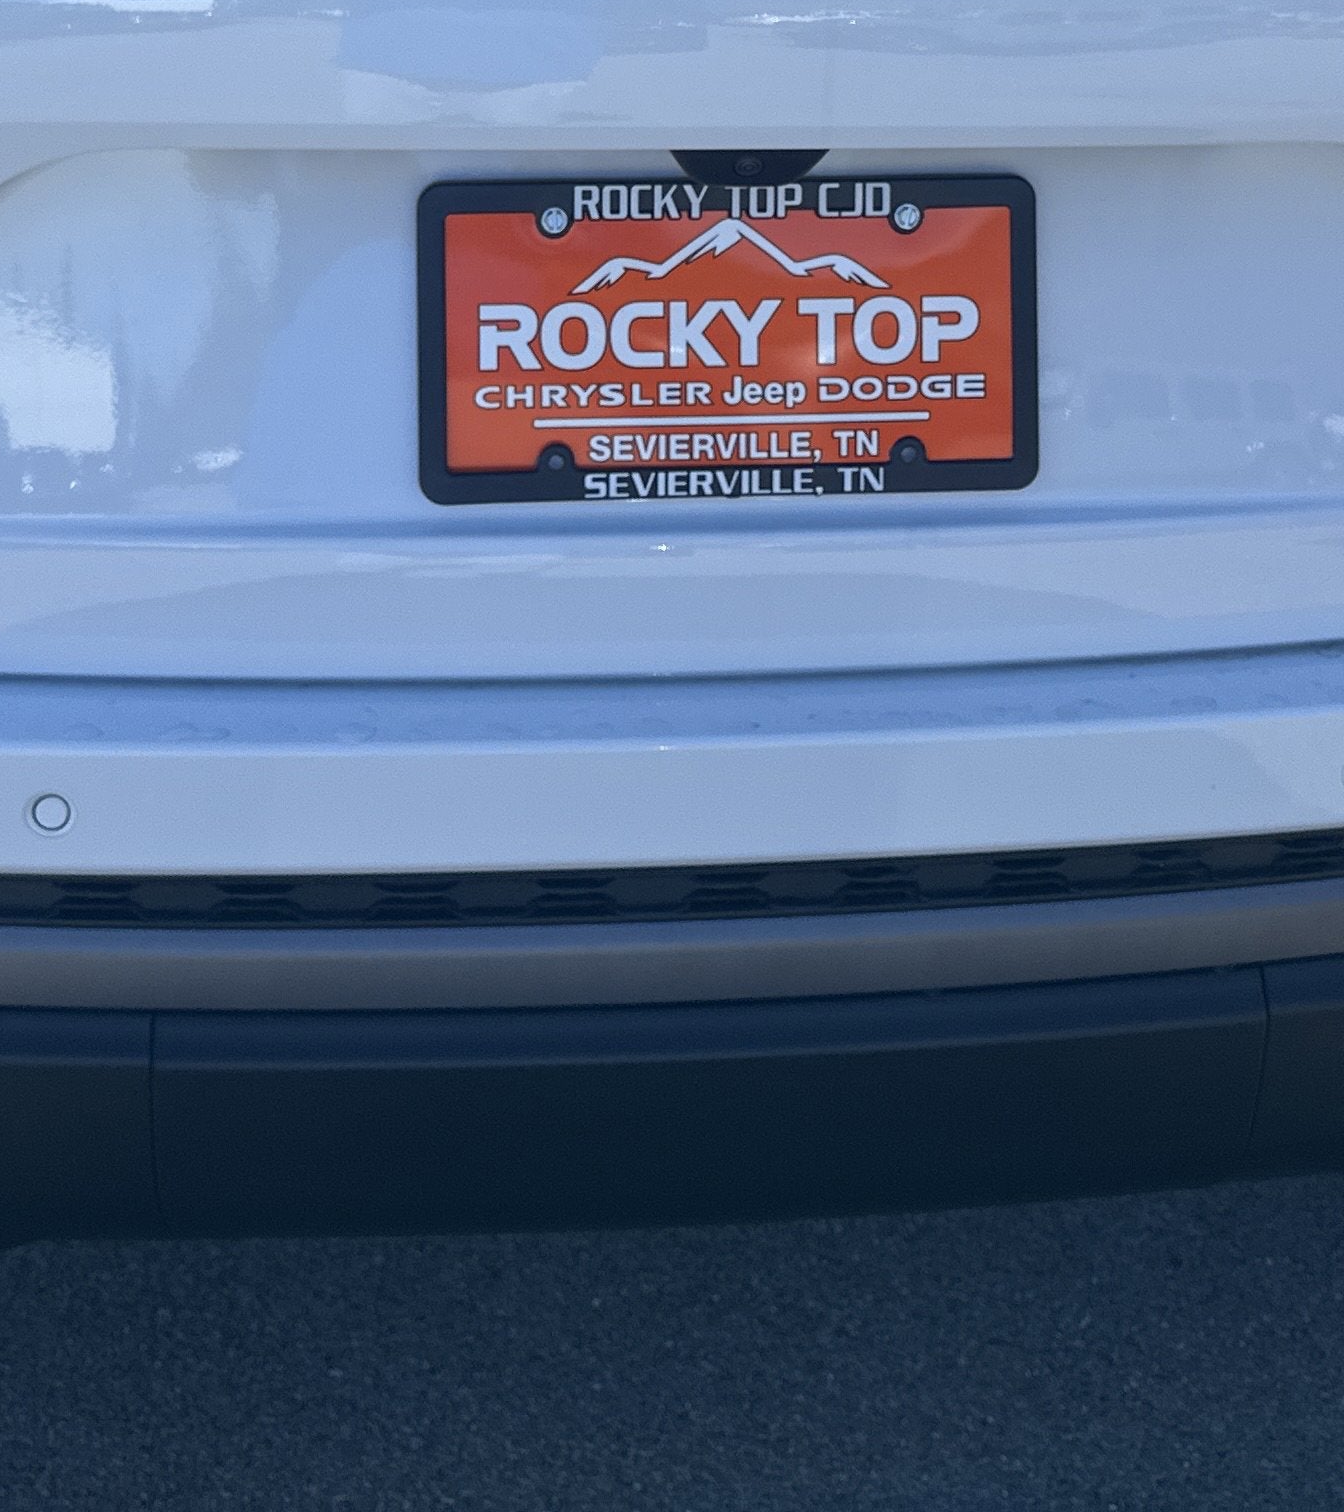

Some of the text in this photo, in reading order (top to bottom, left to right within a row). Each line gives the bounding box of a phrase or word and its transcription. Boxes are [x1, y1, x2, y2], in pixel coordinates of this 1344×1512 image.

[573, 180, 892, 221] ROCKY TOP CJD
[478, 295, 981, 371] ROCKY TOP
[474, 373, 986, 409] CHRYSLER Jeep DODGE
[589, 430, 879, 463] SEVIERVILLE, TN
[584, 467, 885, 499] SEVIERVILLE, TN
